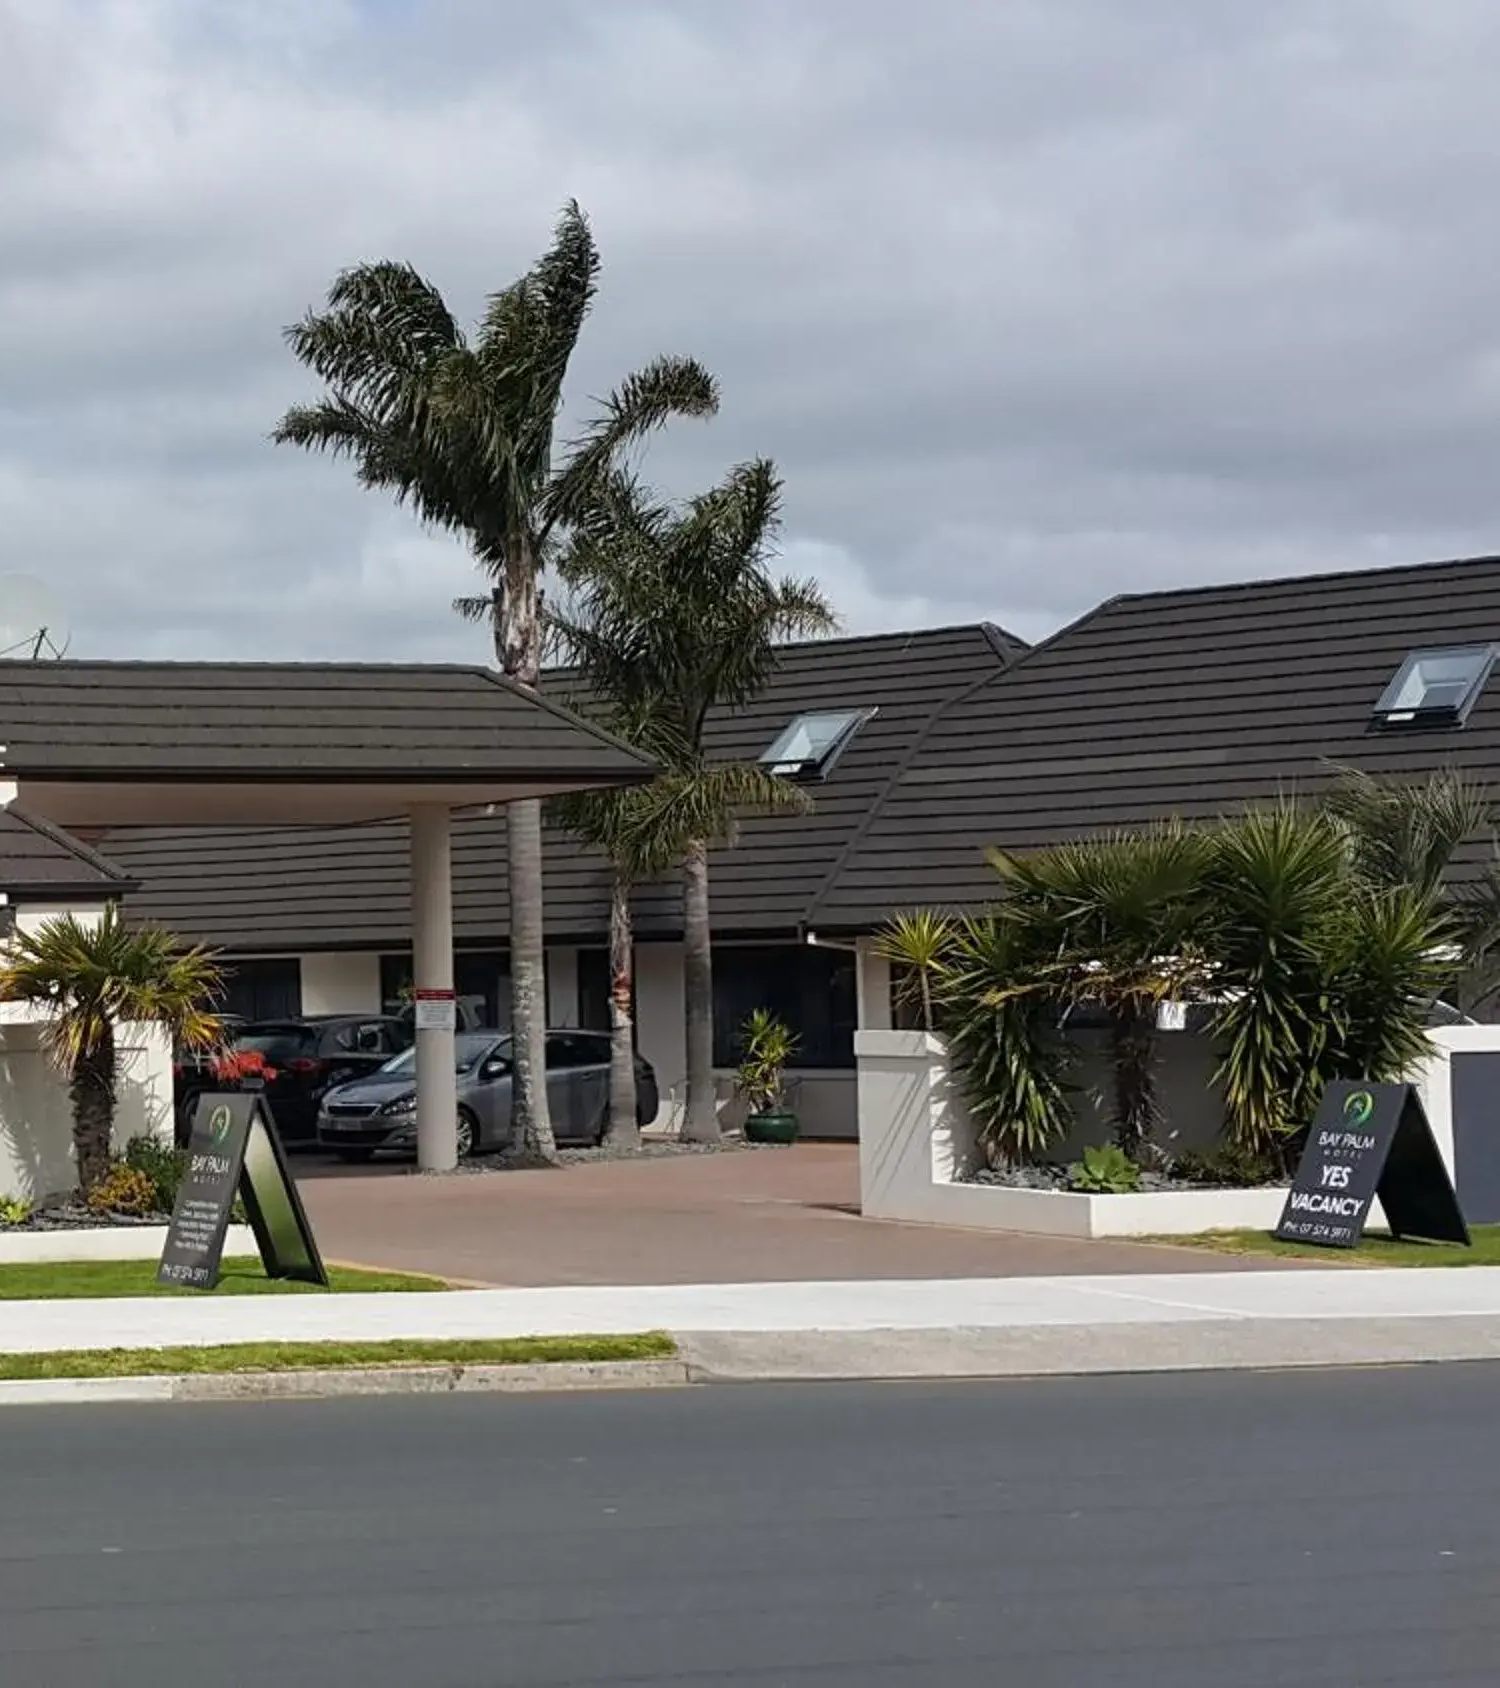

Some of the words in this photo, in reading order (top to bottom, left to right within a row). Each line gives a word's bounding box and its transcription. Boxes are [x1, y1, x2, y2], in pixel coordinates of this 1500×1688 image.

[1318, 1131, 1342, 1146] BAY
[1341, 1133, 1376, 1150] PALM
[1323, 1148, 1363, 1159] MOTEL
[190, 1154, 209, 1171] BAY
[206, 1155, 229, 1173] PALM
[1321, 1165, 1353, 1187] YES
[1290, 1193, 1364, 1217] VACANCY
